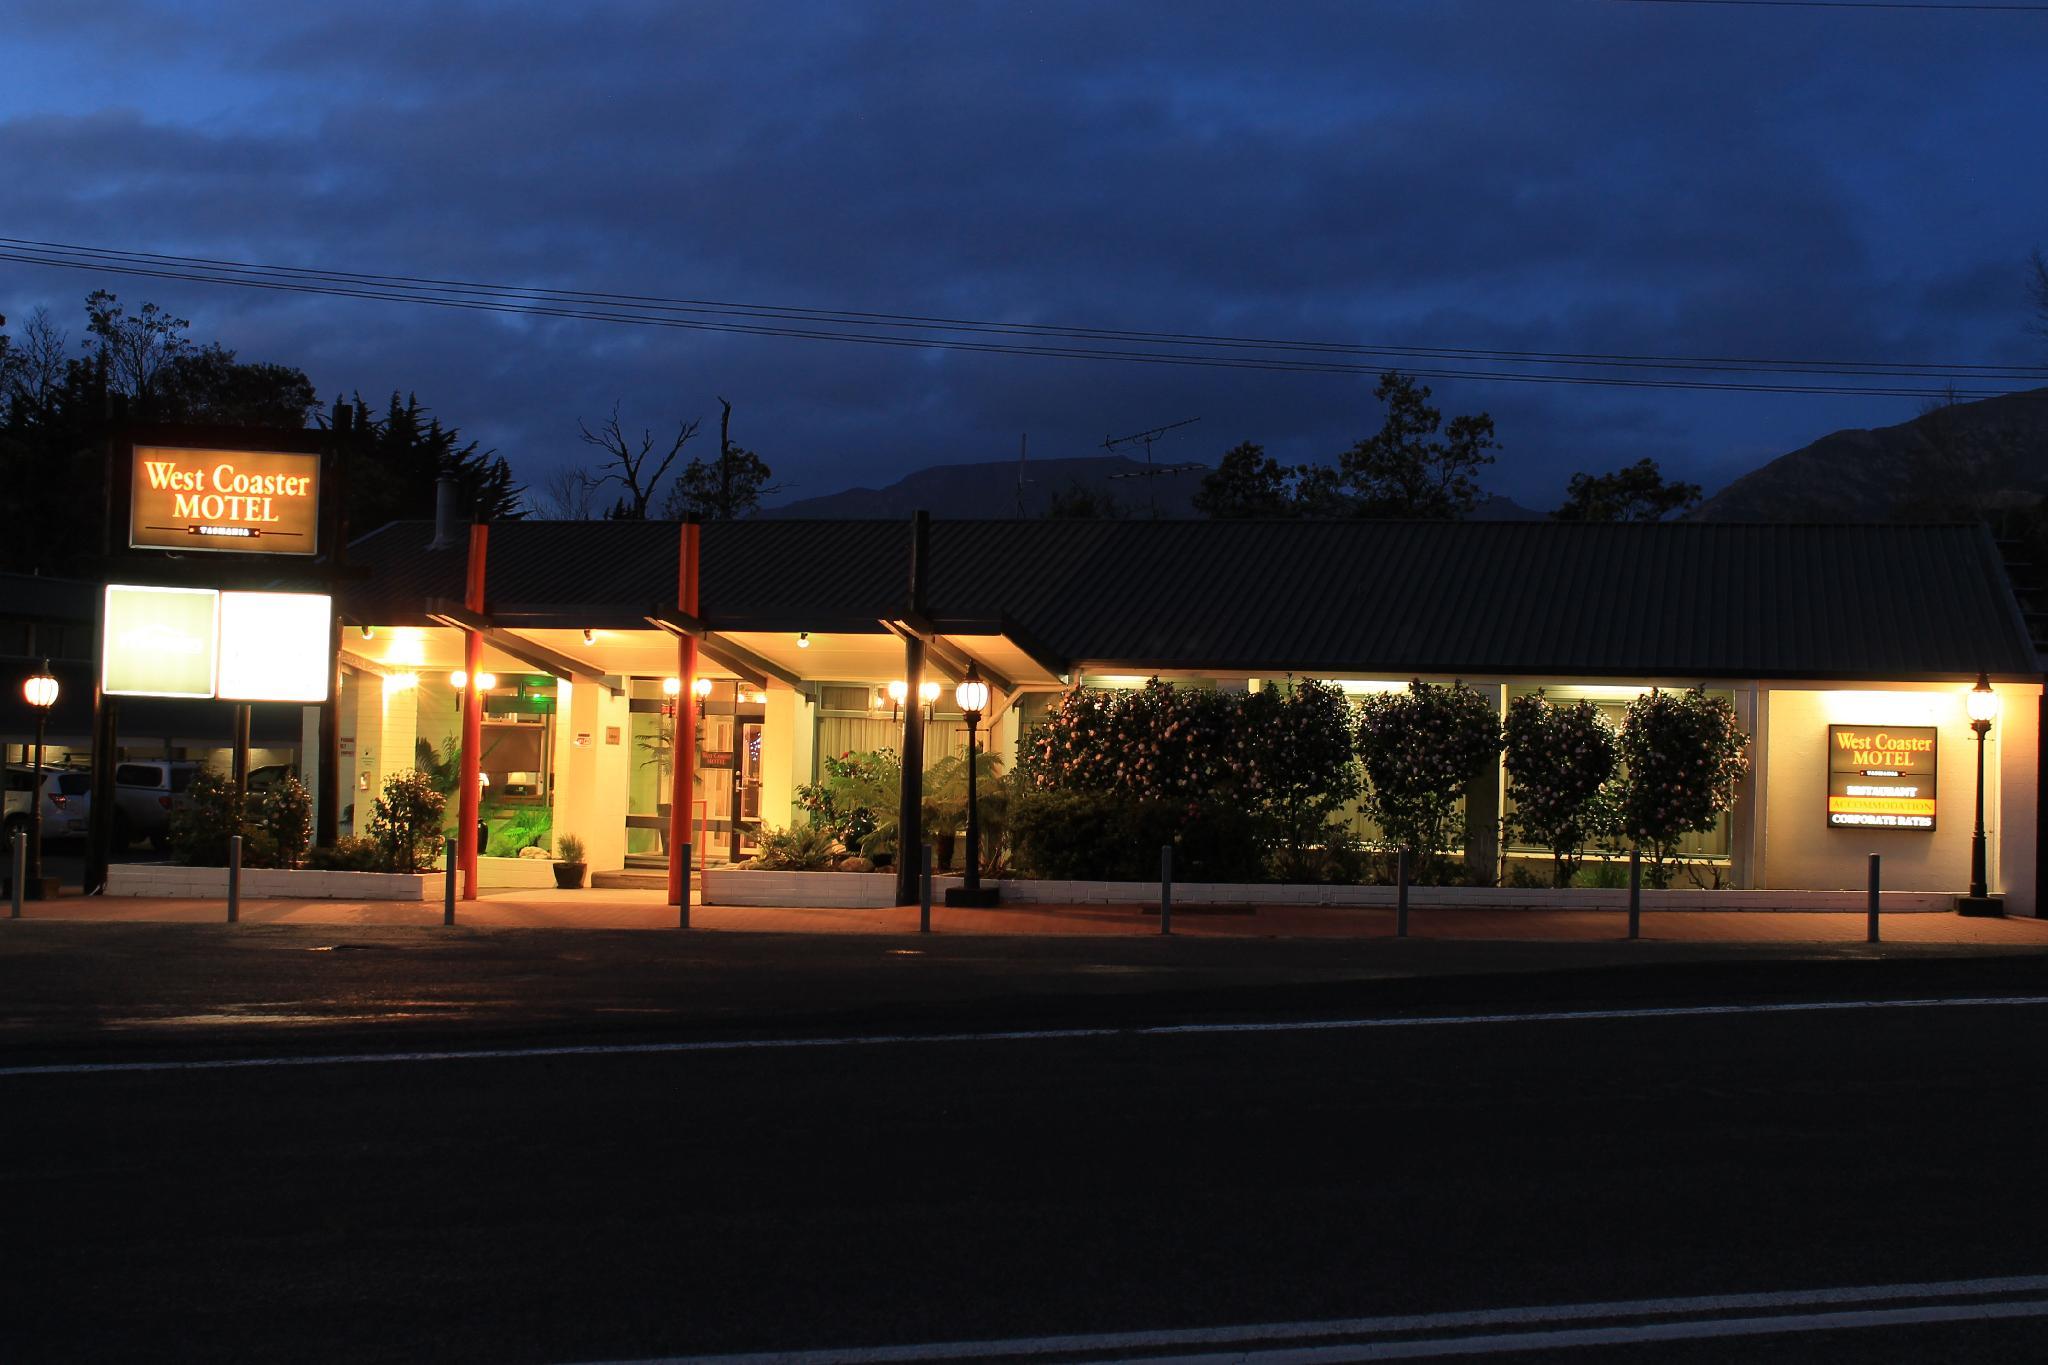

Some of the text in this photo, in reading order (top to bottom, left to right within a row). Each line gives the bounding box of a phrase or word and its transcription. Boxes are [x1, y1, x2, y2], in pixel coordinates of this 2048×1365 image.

[144, 461, 310, 496] West Coaster
[172, 493, 279, 522] MOTEL
[200, 527, 250, 537] TASMANIA
[1837, 732, 1932, 751] West Coaster
[1853, 751, 1914, 766] MOTEL
[1833, 799, 1933, 811] ACCOMMODATION
[1832, 814, 1932, 826] CORPORATE RATES
